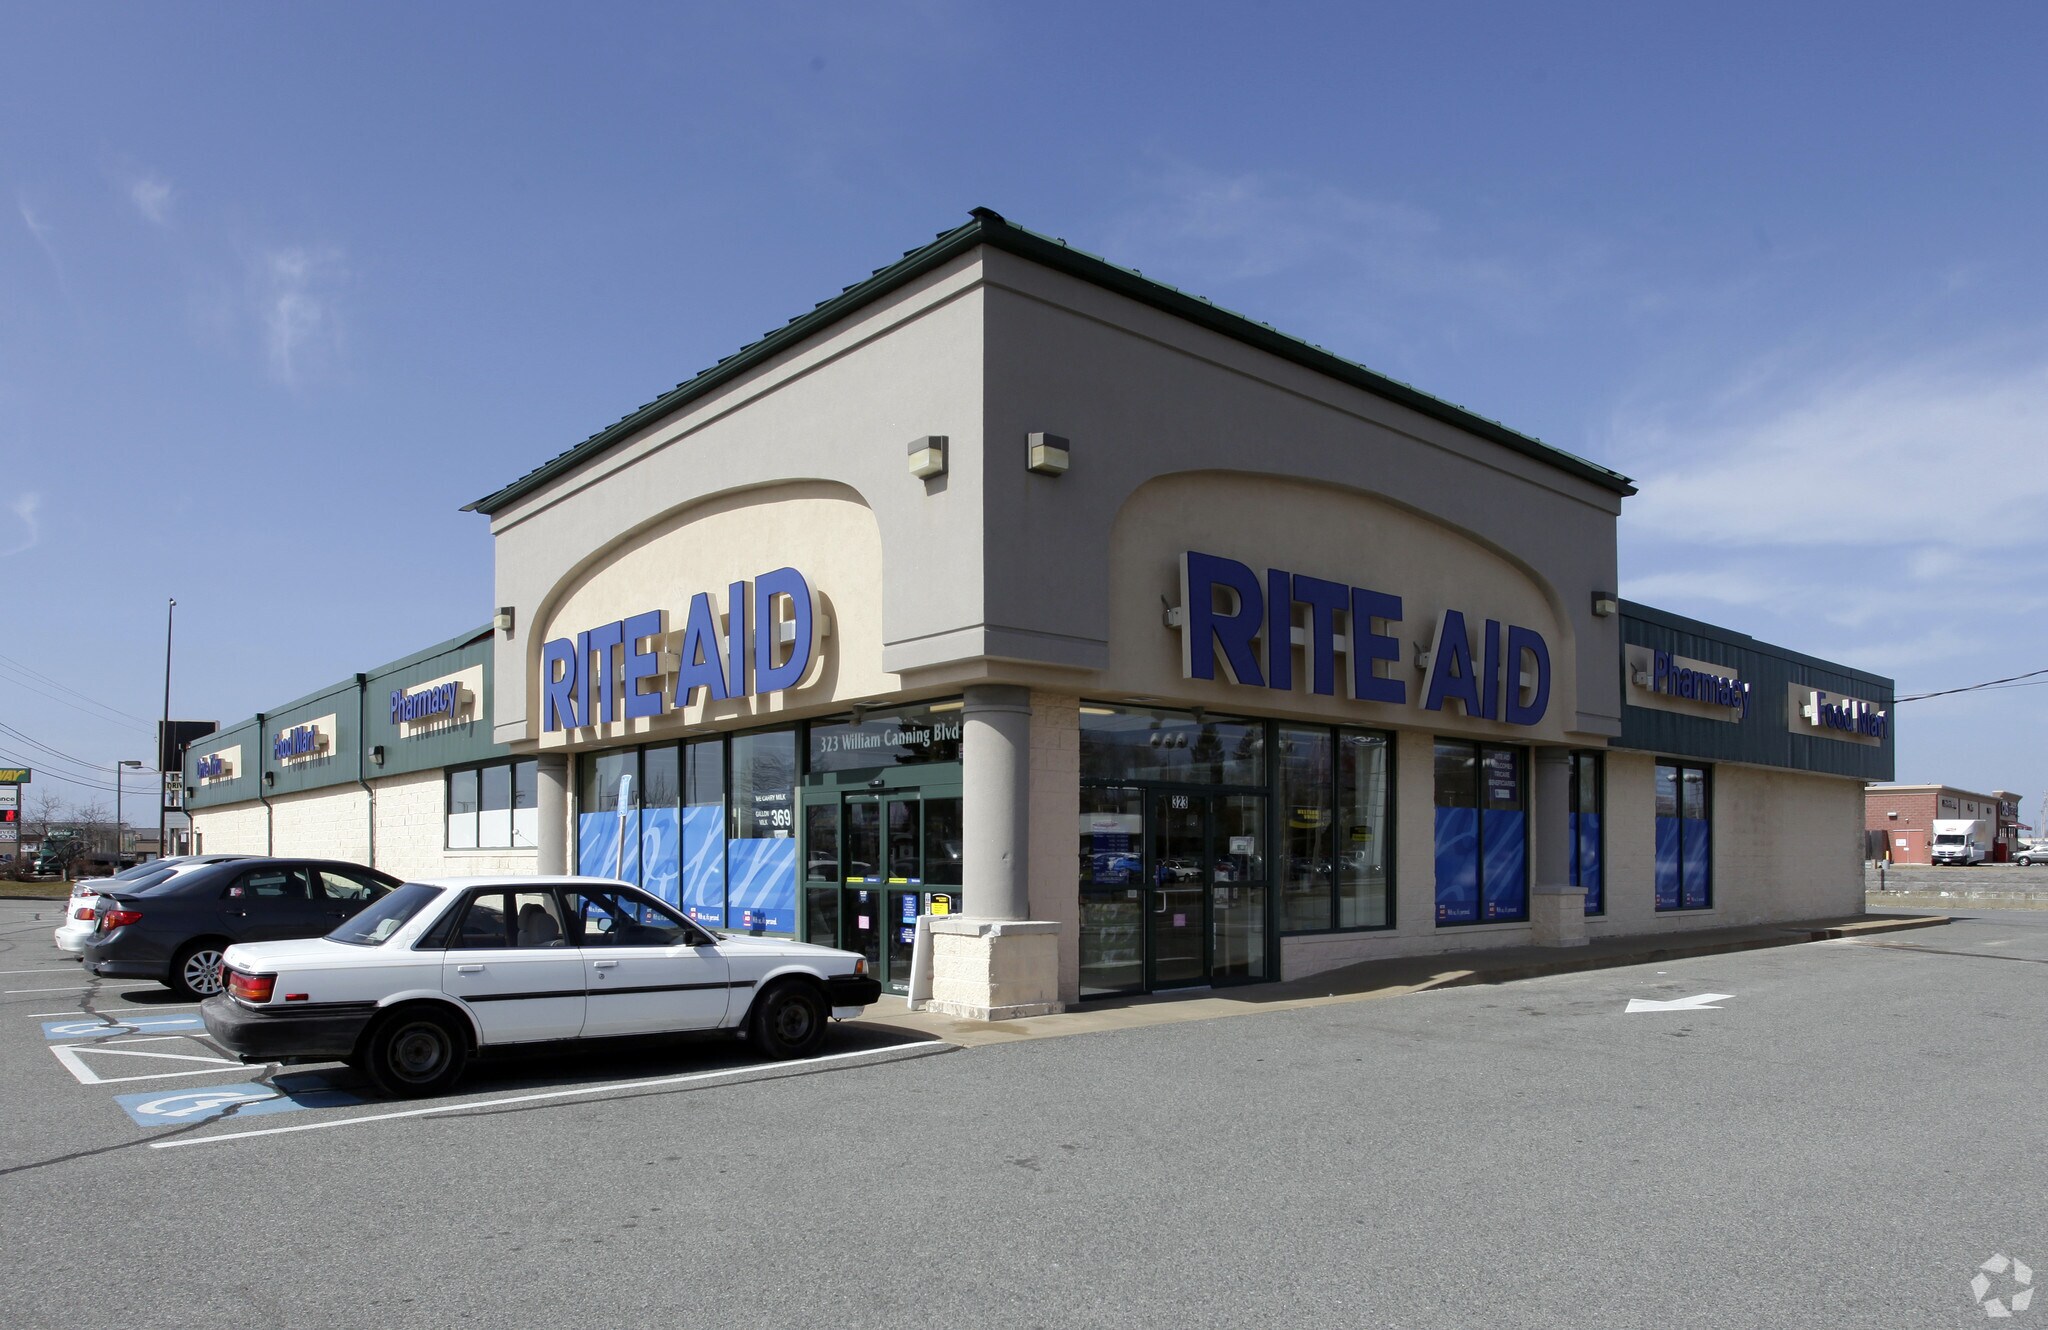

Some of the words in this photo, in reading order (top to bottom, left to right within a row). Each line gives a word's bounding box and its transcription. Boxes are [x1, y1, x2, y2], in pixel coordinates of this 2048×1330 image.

[543, 609, 666, 733] RITE
[674, 566, 818, 708] AID
[1182, 551, 1407, 704] RITE
[1420, 609, 1551, 726] AID
[390, 681, 458, 725] Pharmacy
[1653, 649, 1750, 719] Pharmacy
[820, 735, 839, 753] 323
[842, 733, 881, 750] William
[884, 726, 931, 747] Canning
[933, 721, 960, 741] Blvd
[1813, 691, 1854, 732] Food
[1856, 700, 1889, 739] Mart
[273, 728, 294, 760] Food
[295, 724, 316, 755] Mart
[771, 809, 791, 826] 369
[1172, 795, 1189, 809] 323
